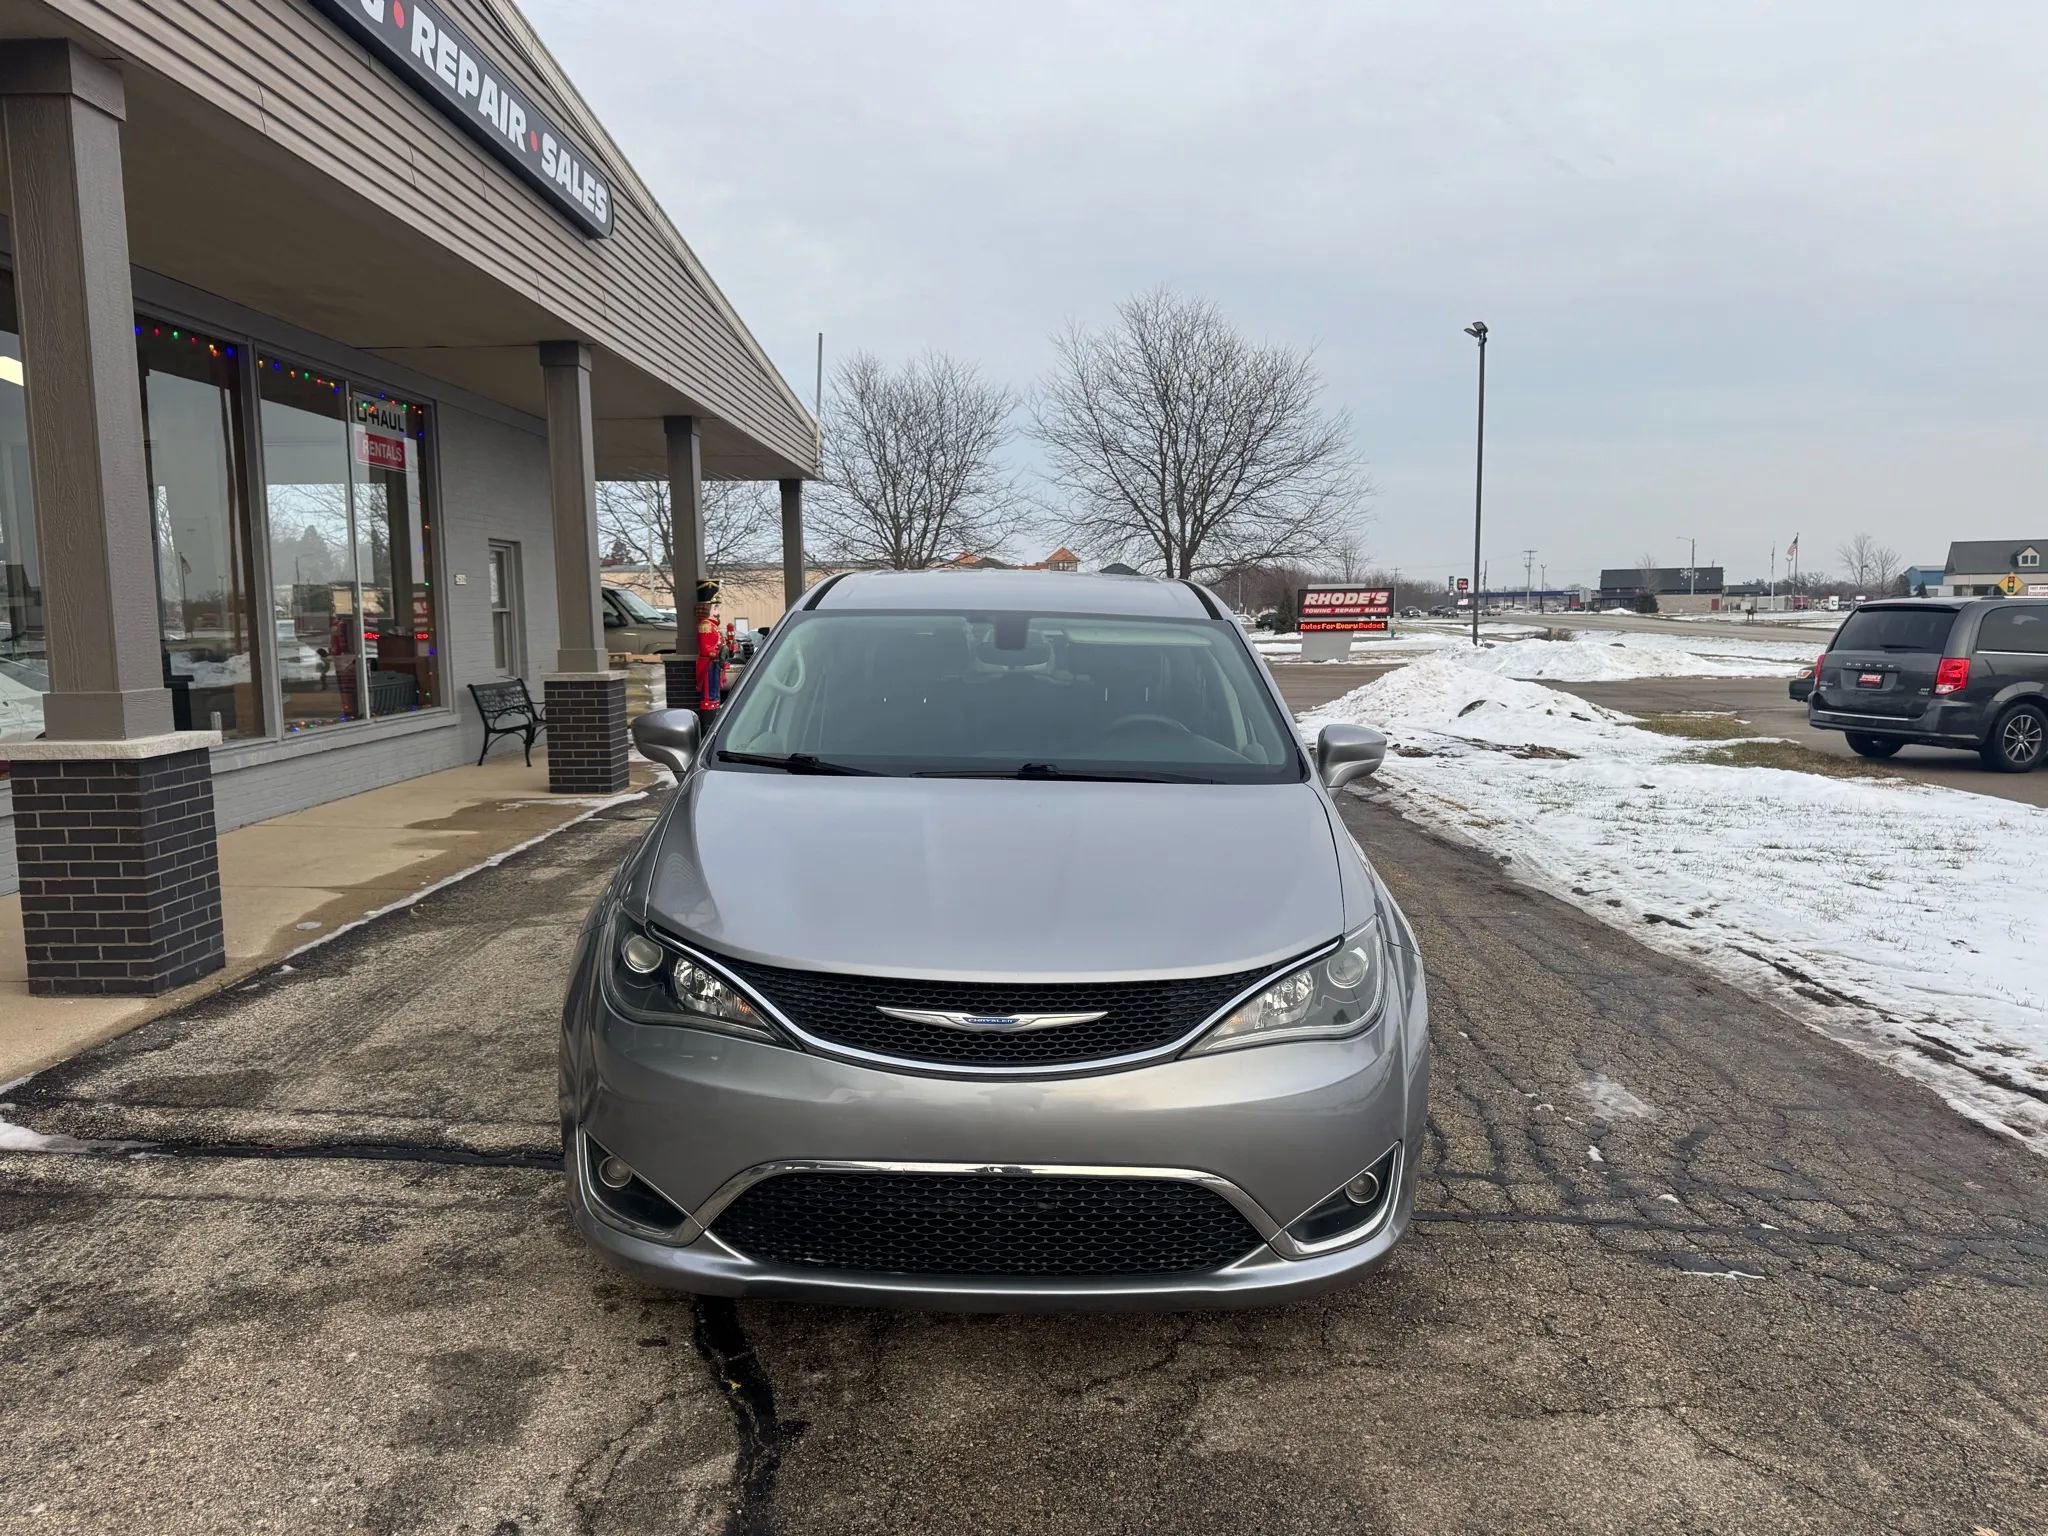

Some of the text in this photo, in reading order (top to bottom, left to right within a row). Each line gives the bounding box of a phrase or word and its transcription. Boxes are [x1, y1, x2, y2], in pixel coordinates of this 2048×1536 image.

[411, 5, 608, 223] REPAIR SALES
[362, 439, 403, 462] RENTALS
[1304, 592, 1389, 605] RHODE'S
[1336, 622, 1359, 630] Every
[1359, 622, 1386, 630] Budget
